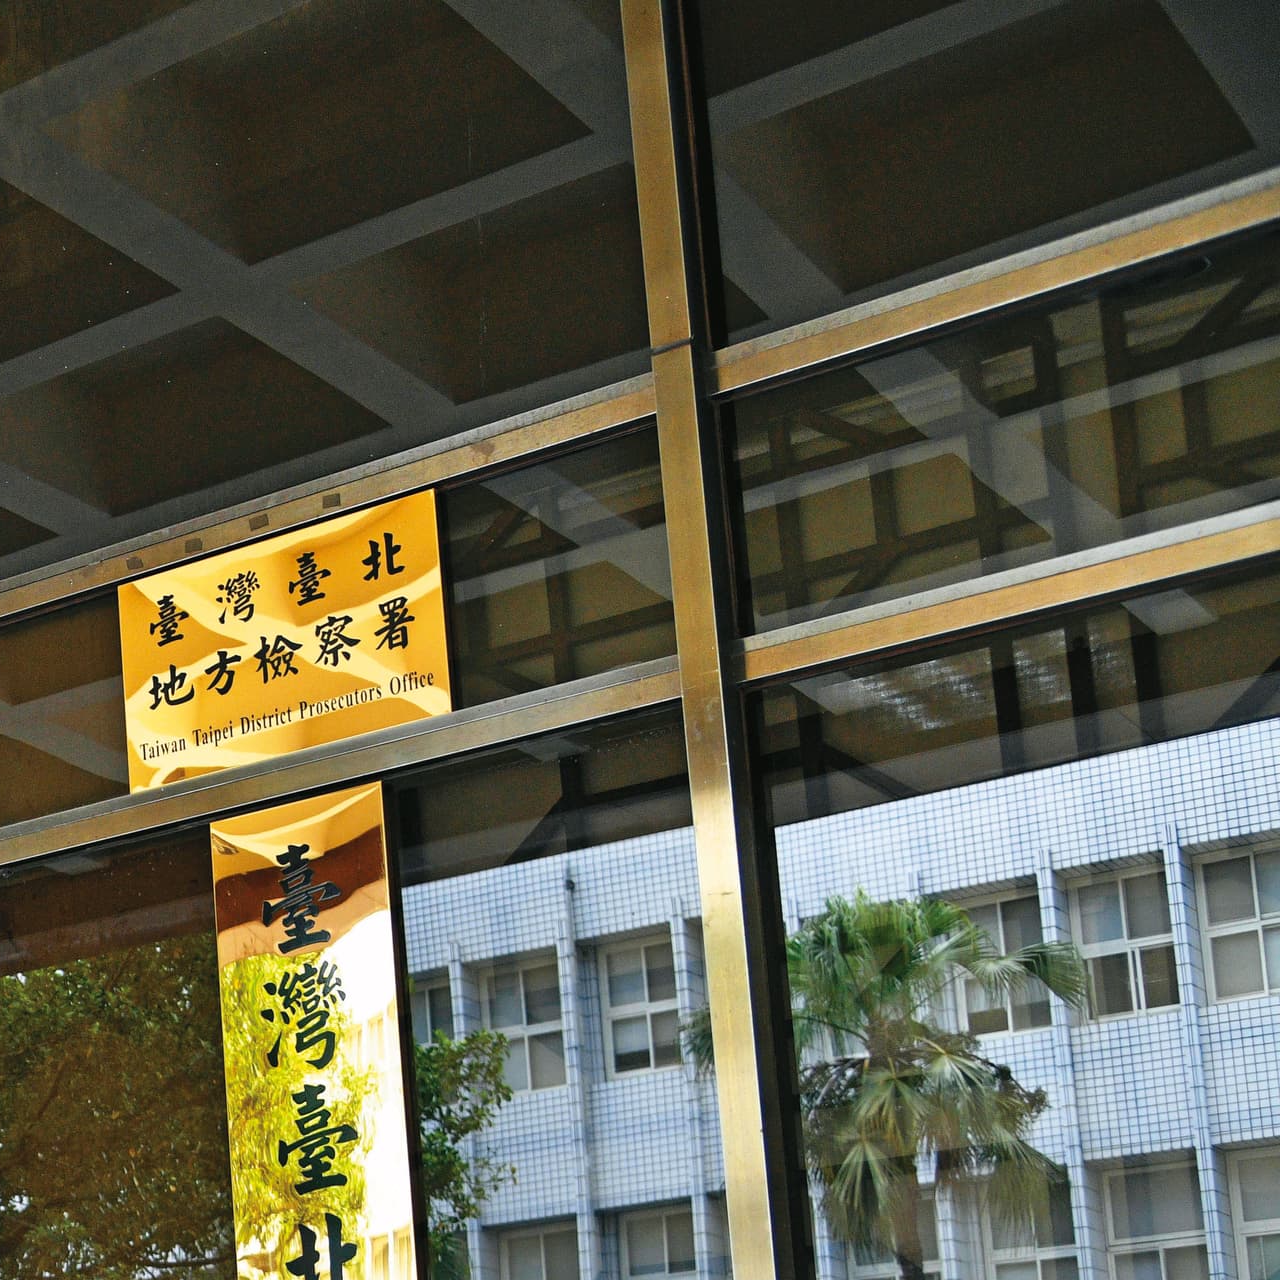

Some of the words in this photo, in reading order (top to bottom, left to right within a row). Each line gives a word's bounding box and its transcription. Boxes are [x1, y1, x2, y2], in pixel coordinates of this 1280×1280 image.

[149, 532, 406, 648] 臺灣臺北
[148, 596, 416, 711] 地方檢察署
[139, 737, 187, 761] Taiwan
[192, 721, 234, 748] Taipei
[239, 706, 293, 735] District
[299, 686, 382, 720] Prosecutors
[389, 671, 435, 696] Office
